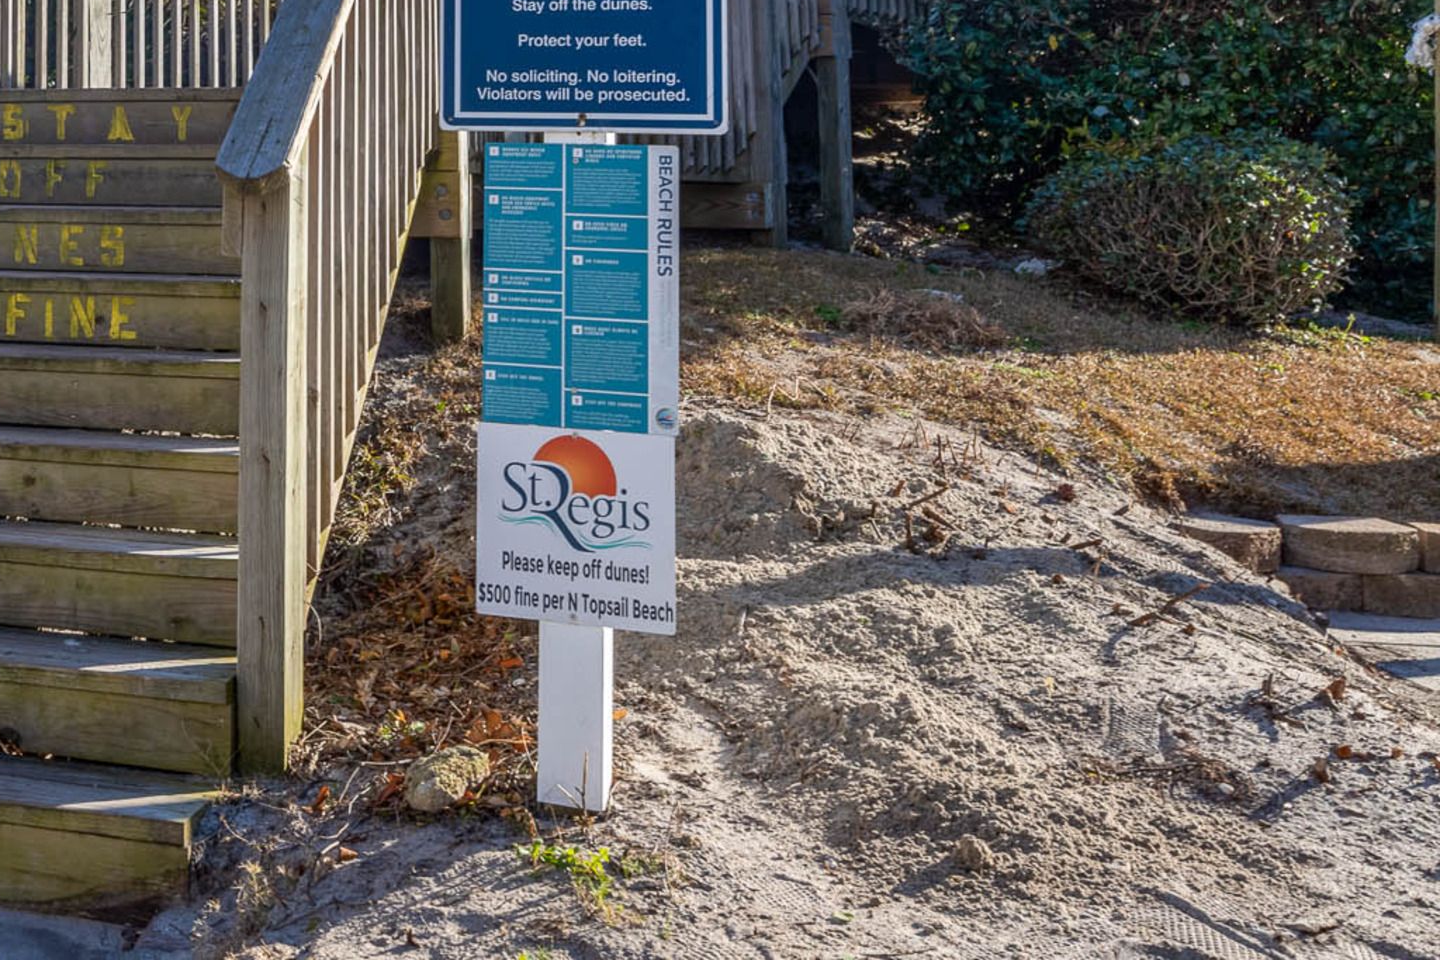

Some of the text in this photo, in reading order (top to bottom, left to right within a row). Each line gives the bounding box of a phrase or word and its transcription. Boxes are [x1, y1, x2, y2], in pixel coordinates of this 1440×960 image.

[518, 34, 647, 50] Protect your feet.
[477, 87, 691, 104] Violators will be prosecuted.
[486, 69, 681, 86] No soliciting. No loitering.
[3, 103, 193, 141] STAY
[658, 155, 673, 212] BEACH
[656, 218, 673, 277] RULES
[5, 293, 137, 340] FINE
[529, 463, 650, 553] Regis
[502, 551, 650, 585] Please keep off dunes!
[478, 582, 674, 623] $500 fine per N Topsail Beach
